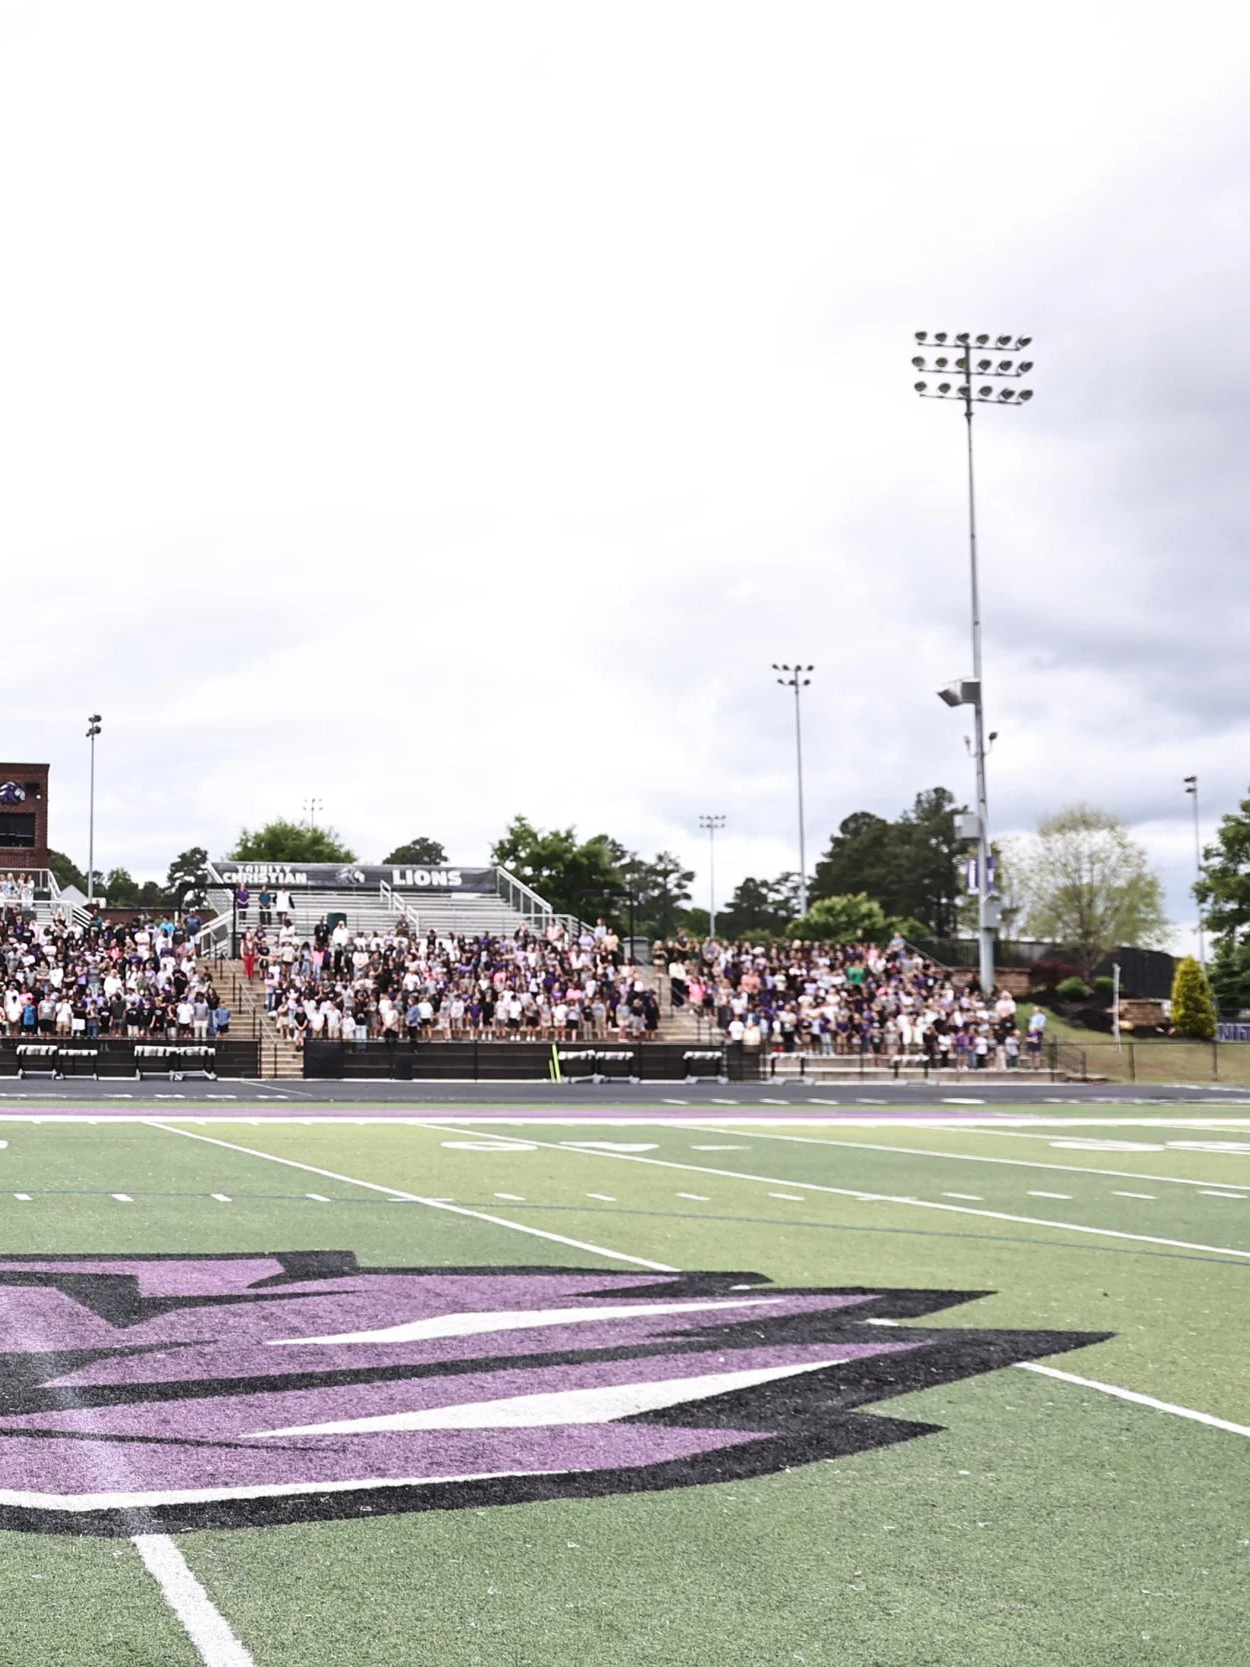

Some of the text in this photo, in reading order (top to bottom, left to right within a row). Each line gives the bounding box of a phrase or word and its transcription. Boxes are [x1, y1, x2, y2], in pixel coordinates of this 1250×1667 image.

[236, 865, 291, 874] TRINITY
[222, 872, 307, 884] CHRISTIAN
[392, 869, 463, 886] LIONS
